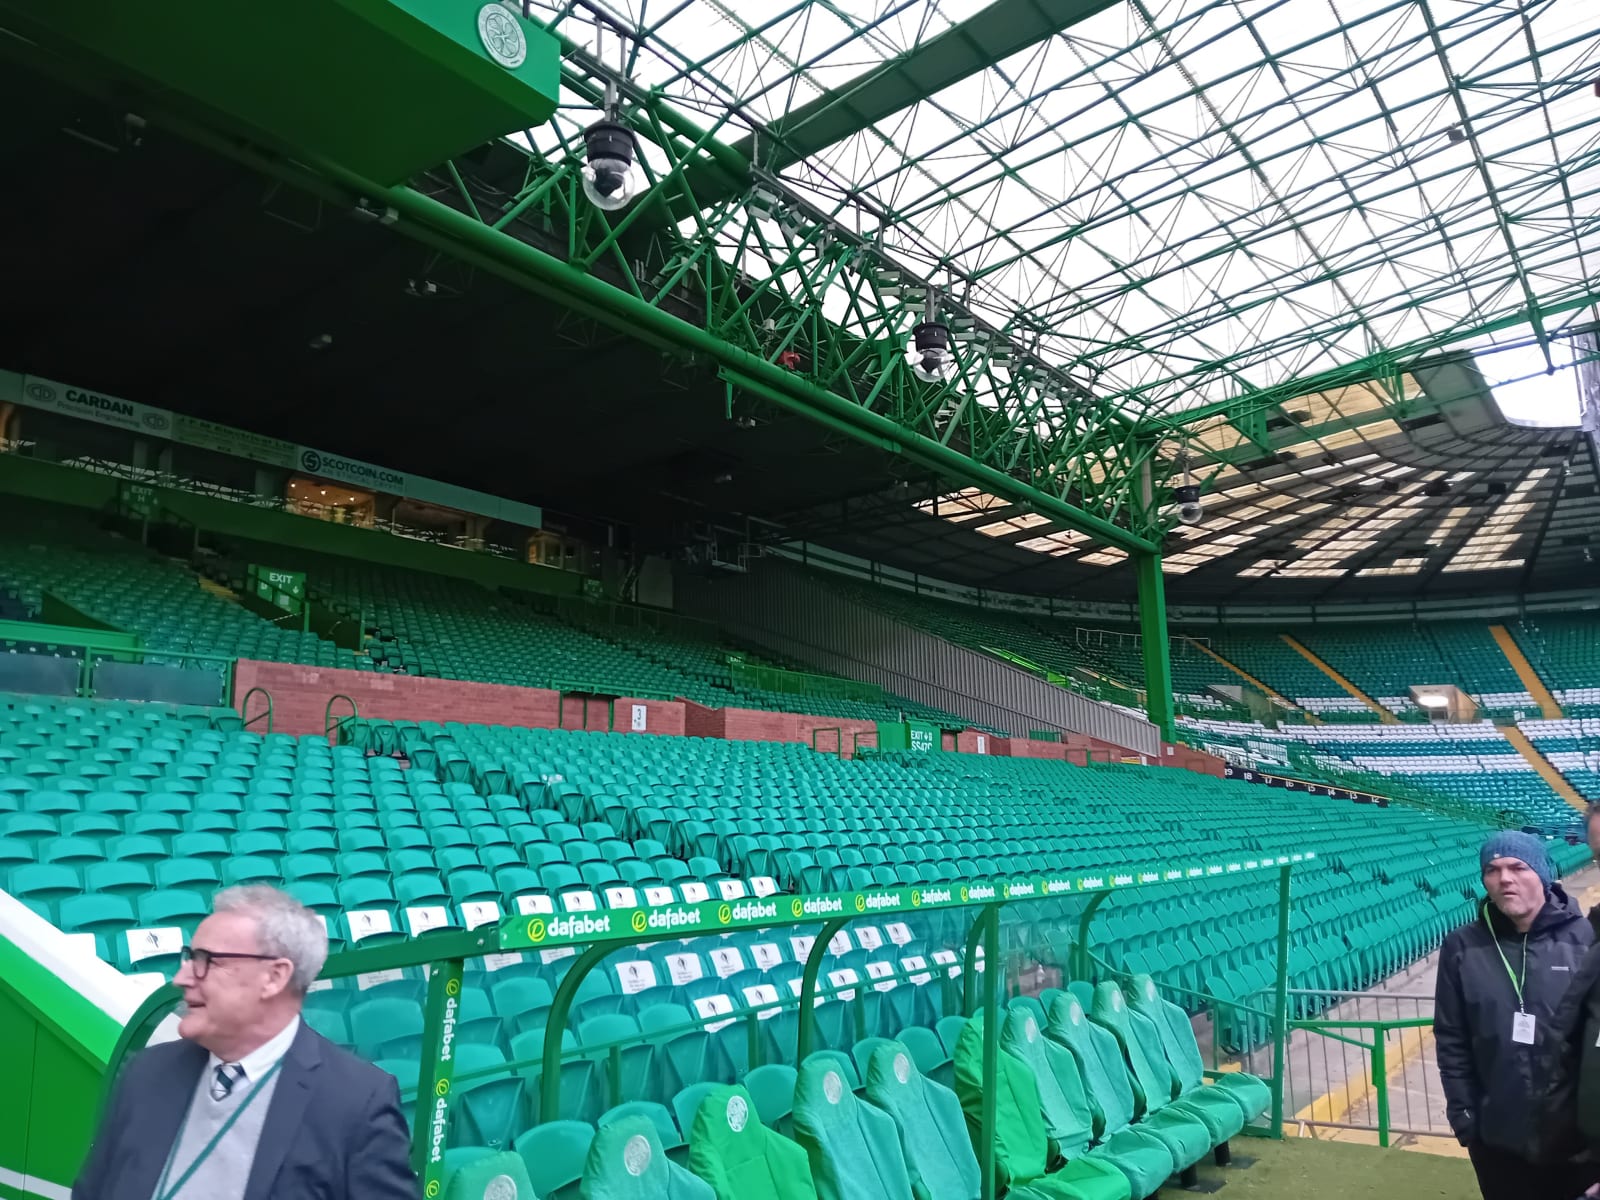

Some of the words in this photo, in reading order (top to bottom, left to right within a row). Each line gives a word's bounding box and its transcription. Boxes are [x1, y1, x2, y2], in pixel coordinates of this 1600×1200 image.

[65, 389, 134, 417] CARDAN
[95, 410, 141, 428] Engineering
[322, 456, 404, 486] SCOTCOIN.COM
[269, 572, 293, 584] EXIT
[910, 730, 923, 740] EXIT
[1243, 772, 1253, 780] 18
[1327, 788, 1336, 796] 14
[921, 888, 951, 904] dafabet
[968, 885, 995, 900] dafabet
[1009, 882, 1034, 896] dafabet
[803, 896, 843, 915] dafabet
[865, 892, 901, 910] dafabet
[648, 907, 701, 930] dafabet
[732, 901, 777, 921] dafabet
[547, 914, 610, 938] dafabet
[441, 997, 457, 1062] dafabet
[430, 1097, 447, 1164] dafabet
